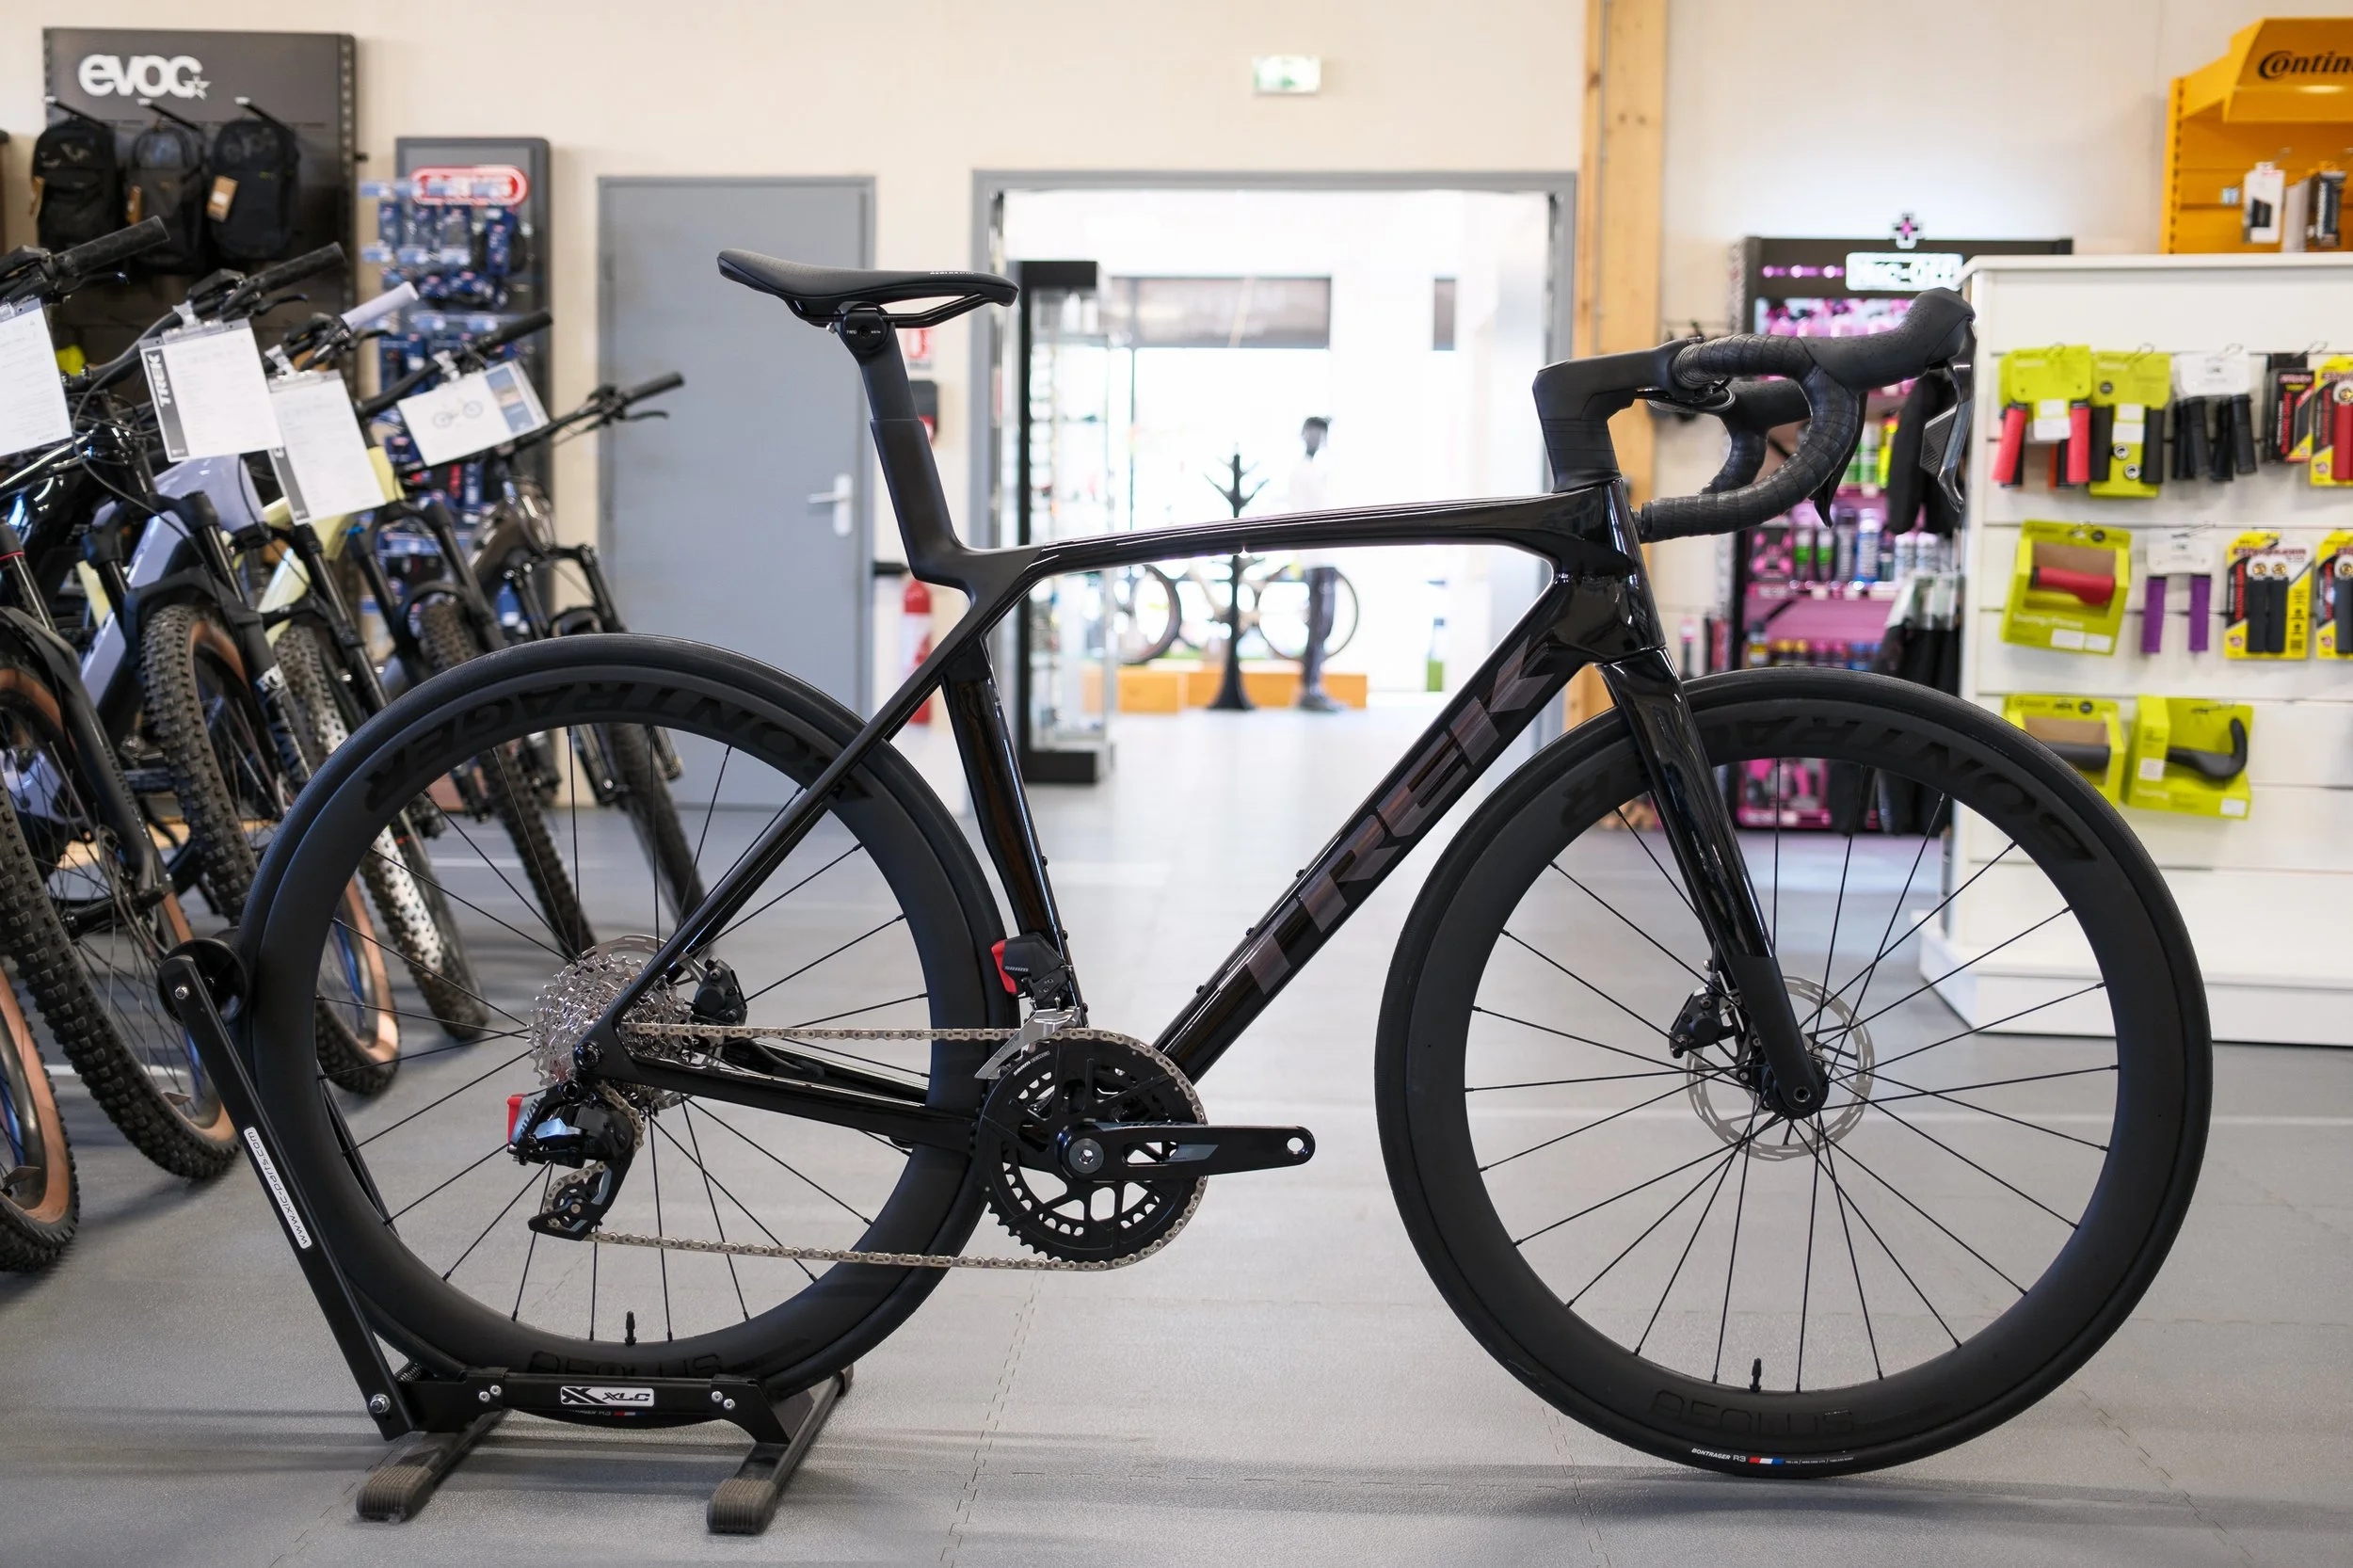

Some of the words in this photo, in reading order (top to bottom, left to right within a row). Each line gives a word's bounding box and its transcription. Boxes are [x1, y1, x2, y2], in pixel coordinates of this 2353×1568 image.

[78, 54, 204, 99] evoc
[2257, 50, 2353, 81] Contin
[147, 353, 171, 408] TREK
[1245, 634, 1555, 996] TREK
[248, 1131, 308, 1244] www.xlc-parts.com
[602, 1391, 651, 1402] XLC
[1691, 1448, 1731, 1461] BONTRAGER
